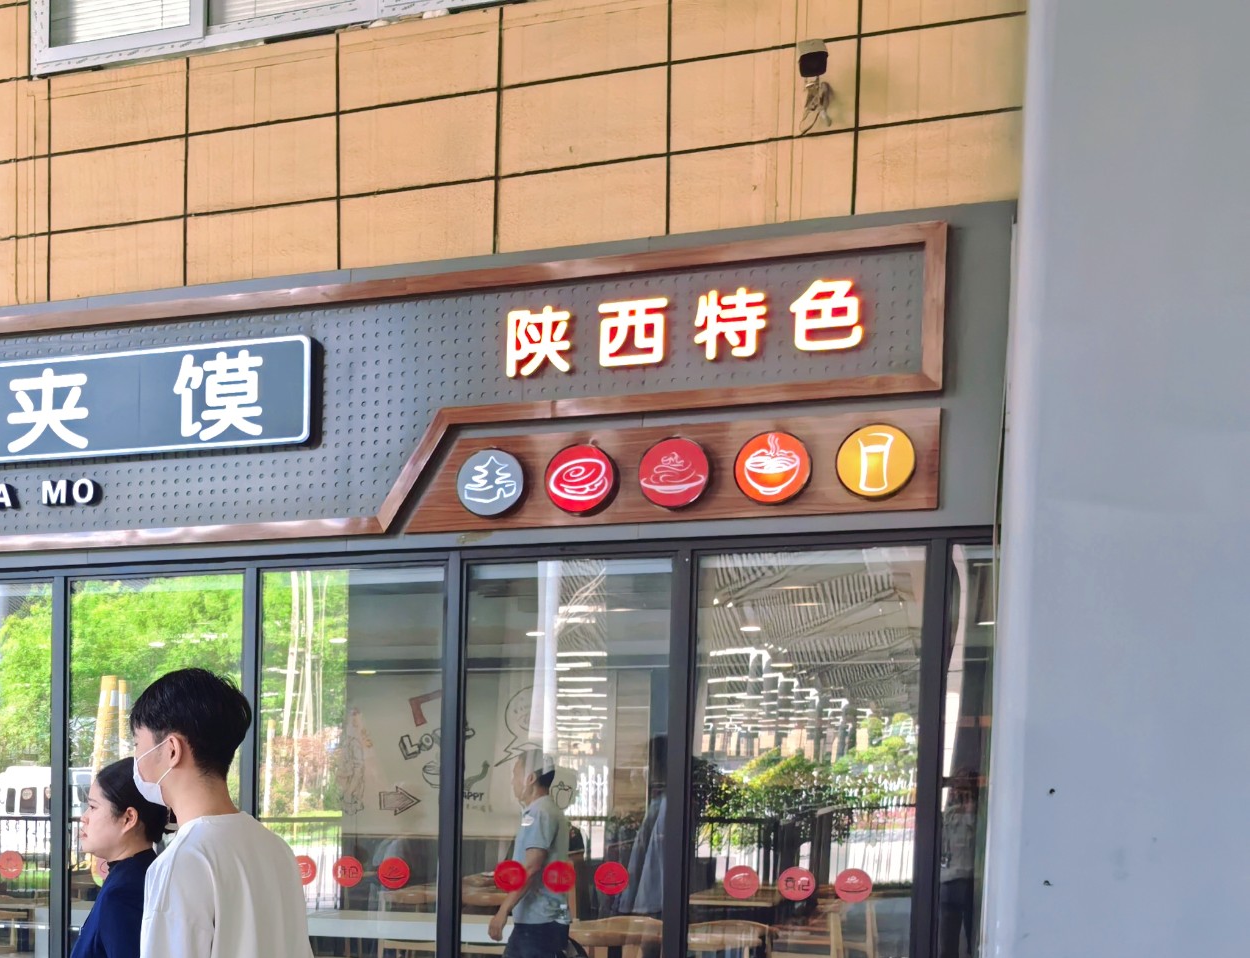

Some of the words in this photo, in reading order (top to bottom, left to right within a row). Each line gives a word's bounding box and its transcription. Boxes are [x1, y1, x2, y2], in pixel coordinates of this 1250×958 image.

[506, 279, 864, 379] 陕西特色
[42, 478, 95, 505] MO
